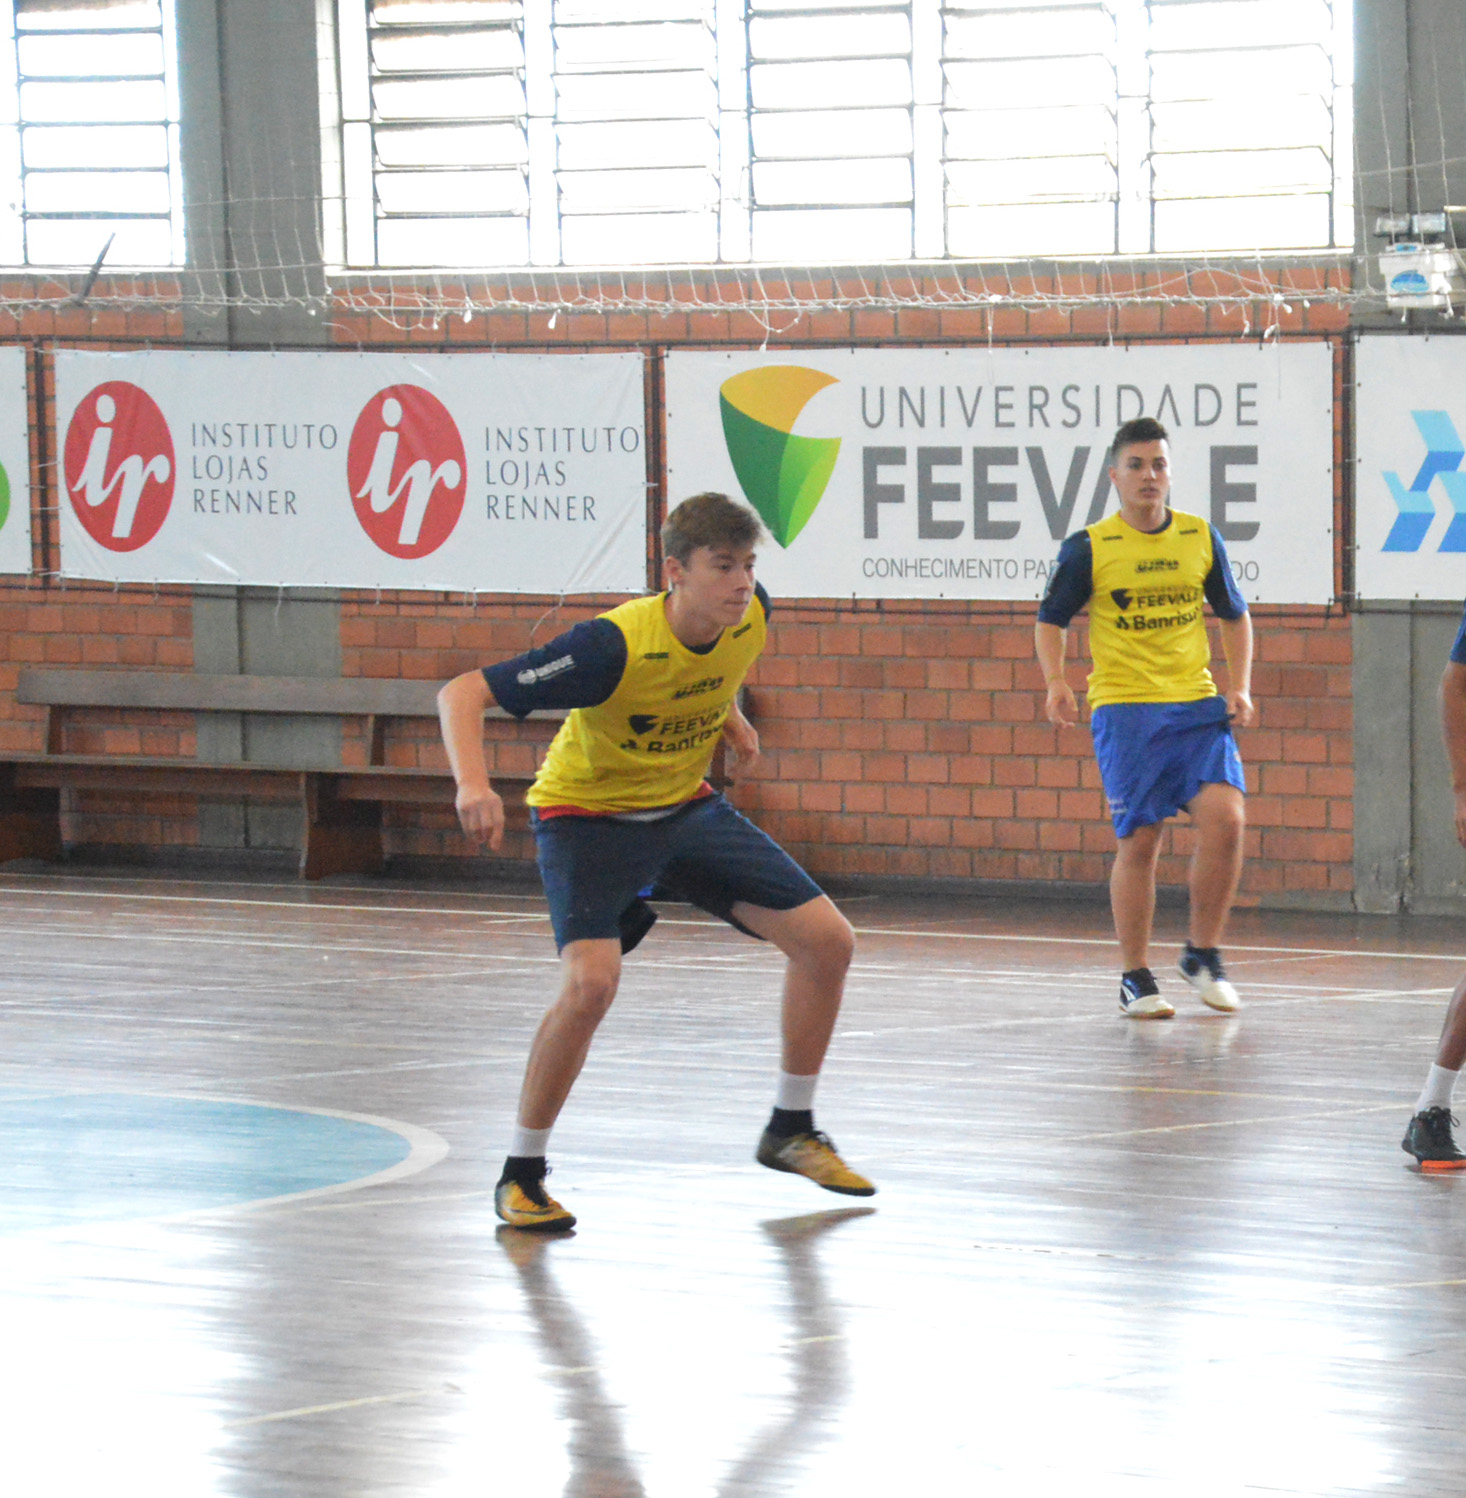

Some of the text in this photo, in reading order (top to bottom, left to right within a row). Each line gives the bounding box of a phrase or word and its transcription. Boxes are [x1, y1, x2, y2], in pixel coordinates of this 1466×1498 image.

[861, 382, 1259, 430] UNIVERSIDADE
[192, 422, 338, 450] INSTITUTO
[485, 426, 640, 453] INSTITUTO
[192, 455, 268, 484] LOJAS
[485, 460, 567, 489] LOJAS
[193, 488, 298, 515] RENNER
[861, 445, 1261, 542] FEEVE
[486, 495, 597, 521] RENNER
[862, 558, 1019, 580] CONHECIMENTO
